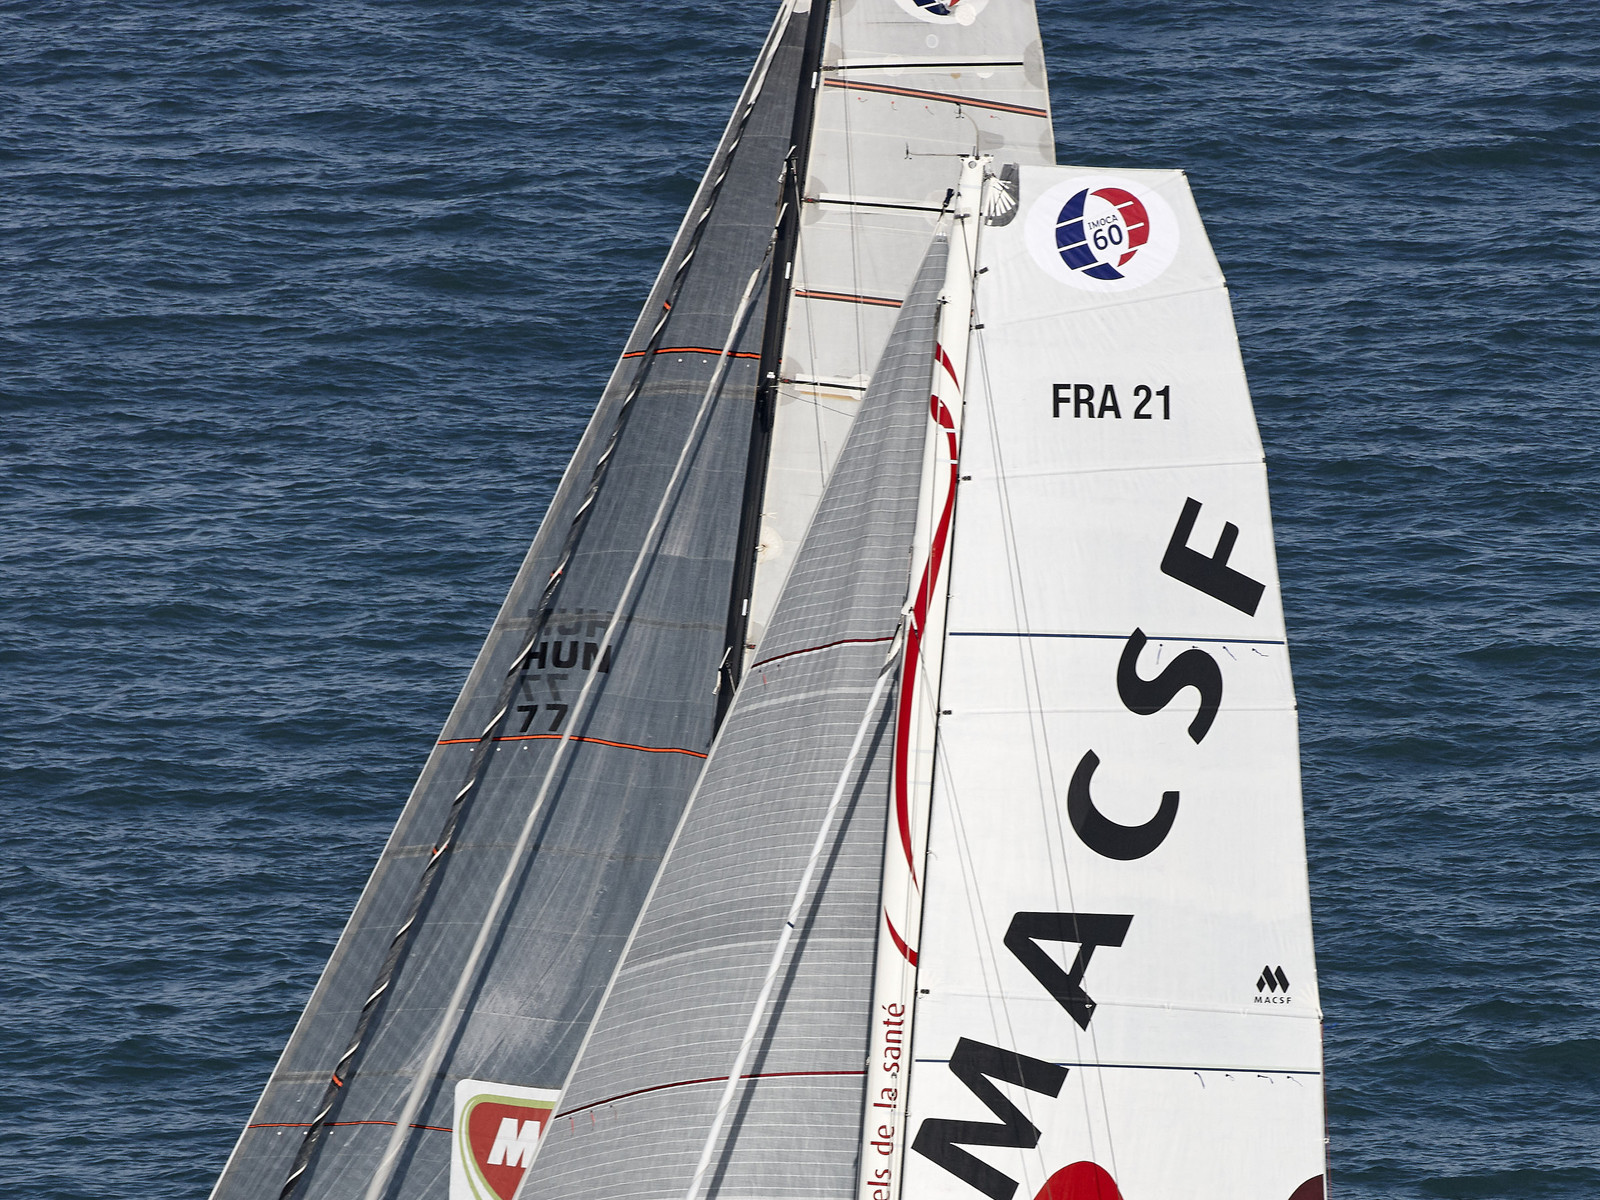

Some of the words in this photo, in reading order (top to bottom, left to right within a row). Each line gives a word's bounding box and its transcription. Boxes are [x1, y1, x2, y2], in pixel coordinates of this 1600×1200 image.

[1088, 214, 1118, 230] IMOCA
[1093, 223, 1123, 250] 60
[1052, 383, 1121, 420] FRA
[1133, 383, 1172, 421] 21
[521, 640, 611, 673] HUN
[517, 703, 568, 732] 77
[1254, 996, 1292, 1004] MACSF
[881, 1002, 905, 1073] santé
[873, 1087, 898, 1109] la
[870, 1124, 894, 1156] de
